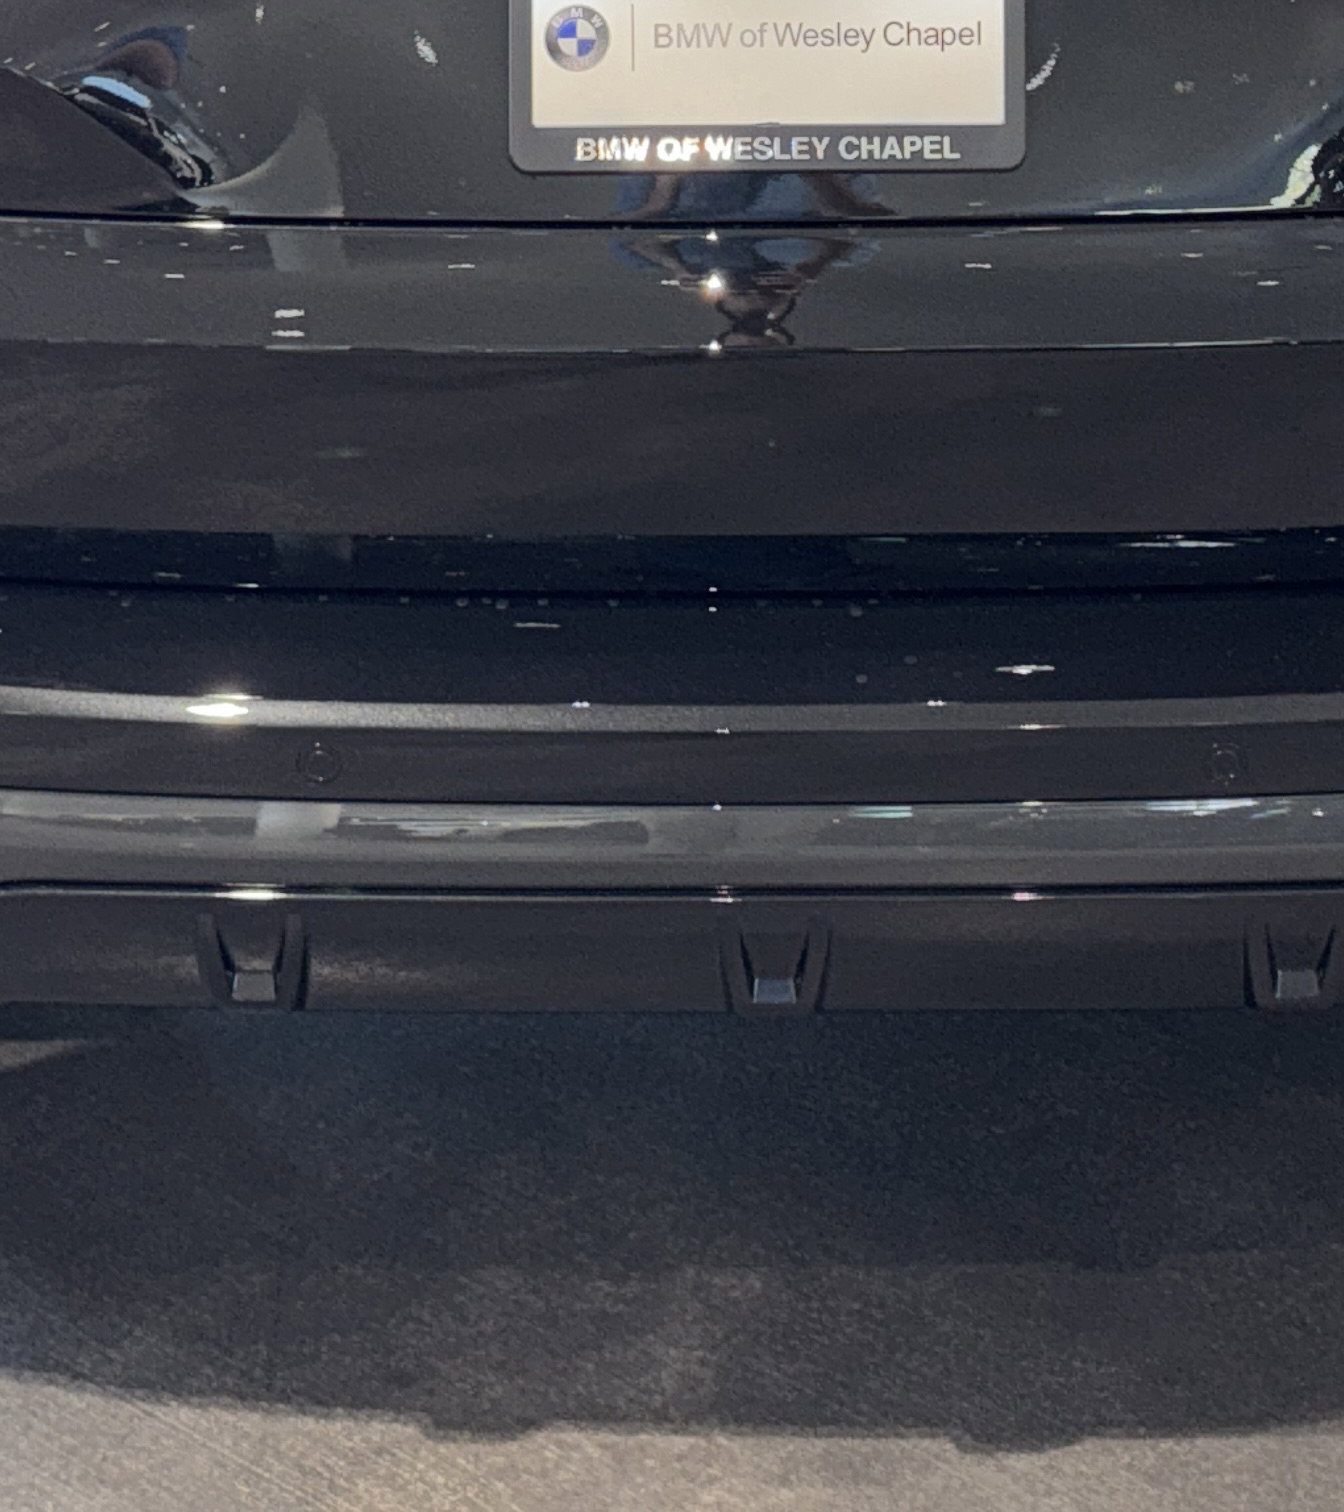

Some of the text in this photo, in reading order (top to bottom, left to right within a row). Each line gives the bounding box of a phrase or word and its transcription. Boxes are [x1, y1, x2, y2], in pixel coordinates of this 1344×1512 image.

[654, 20, 982, 54] BMW of Wesley Chapel
[575, 135, 961, 162] BMW OF WESLEY CHAPEL
